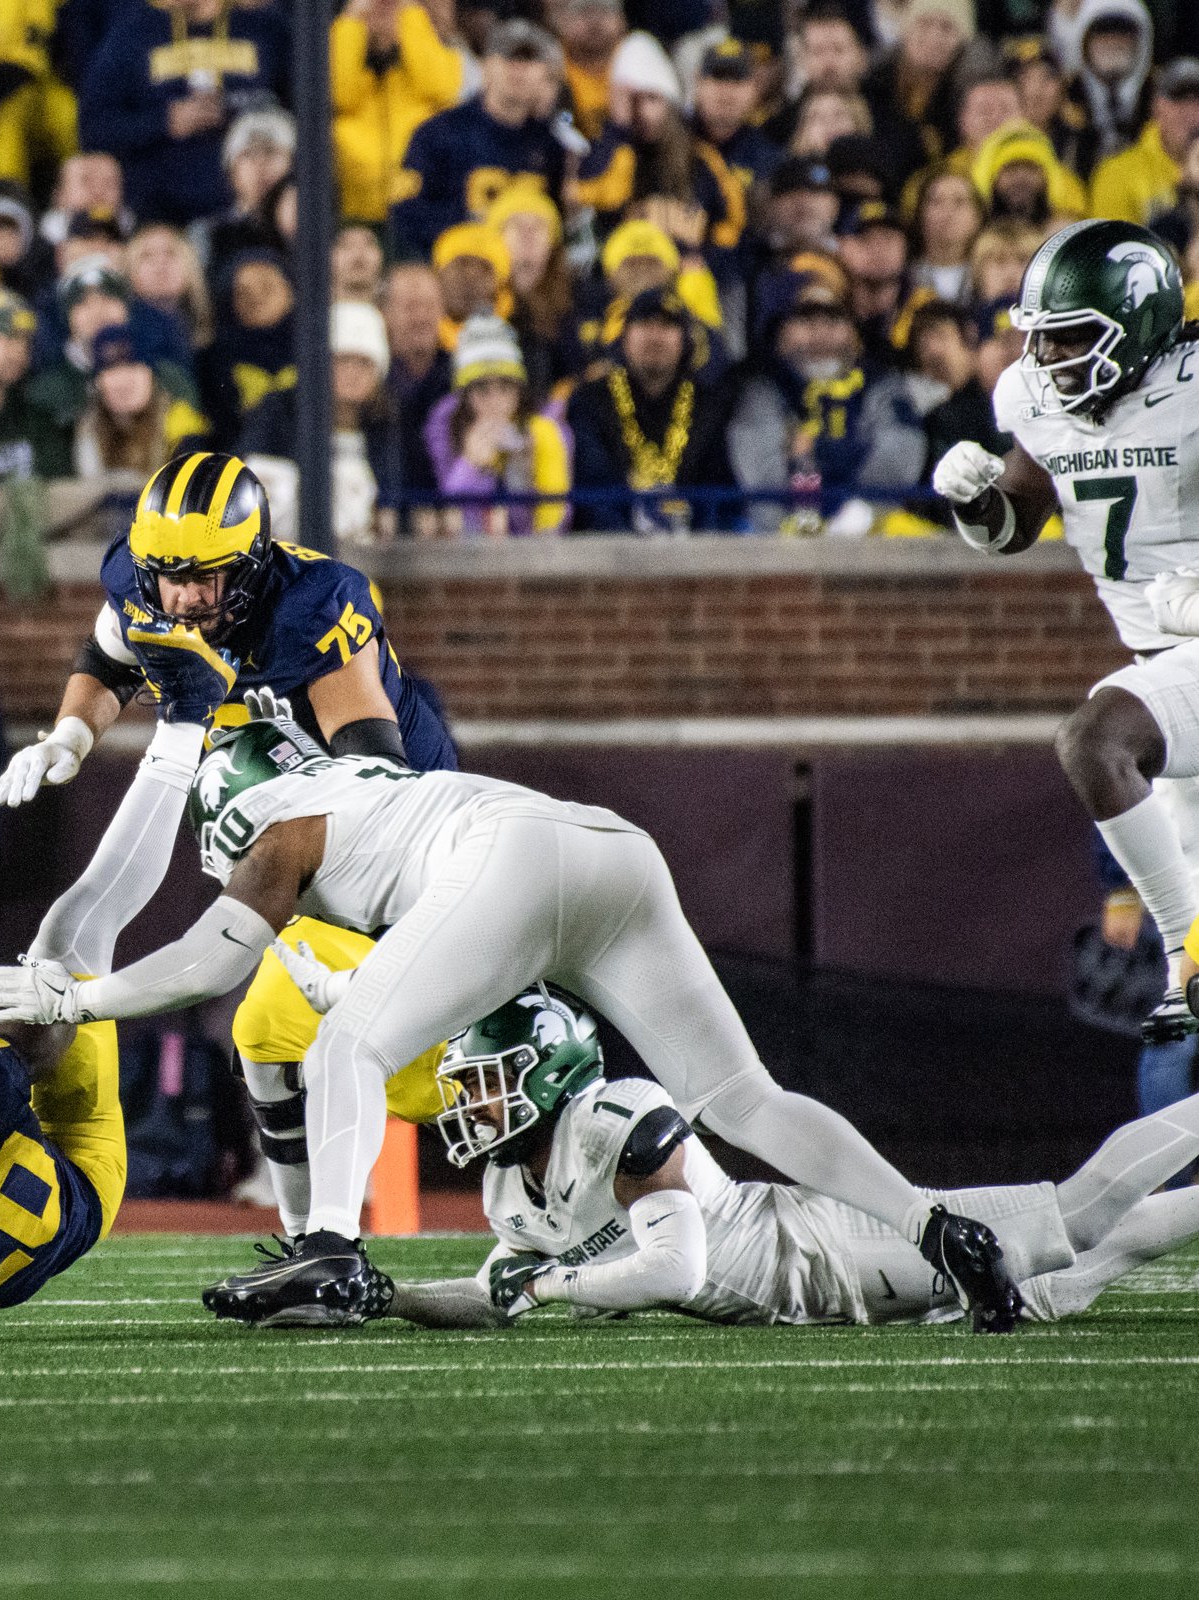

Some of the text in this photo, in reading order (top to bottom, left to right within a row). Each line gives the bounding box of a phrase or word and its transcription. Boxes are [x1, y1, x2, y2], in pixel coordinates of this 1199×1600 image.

[1122, 446, 1178, 467] STATE
[1073, 475, 1138, 581] 7
[315, 601, 372, 665] 75
[213, 807, 254, 860] 10
[593, 1101, 634, 1120] 1
[582, 1218, 628, 1257] STATE
